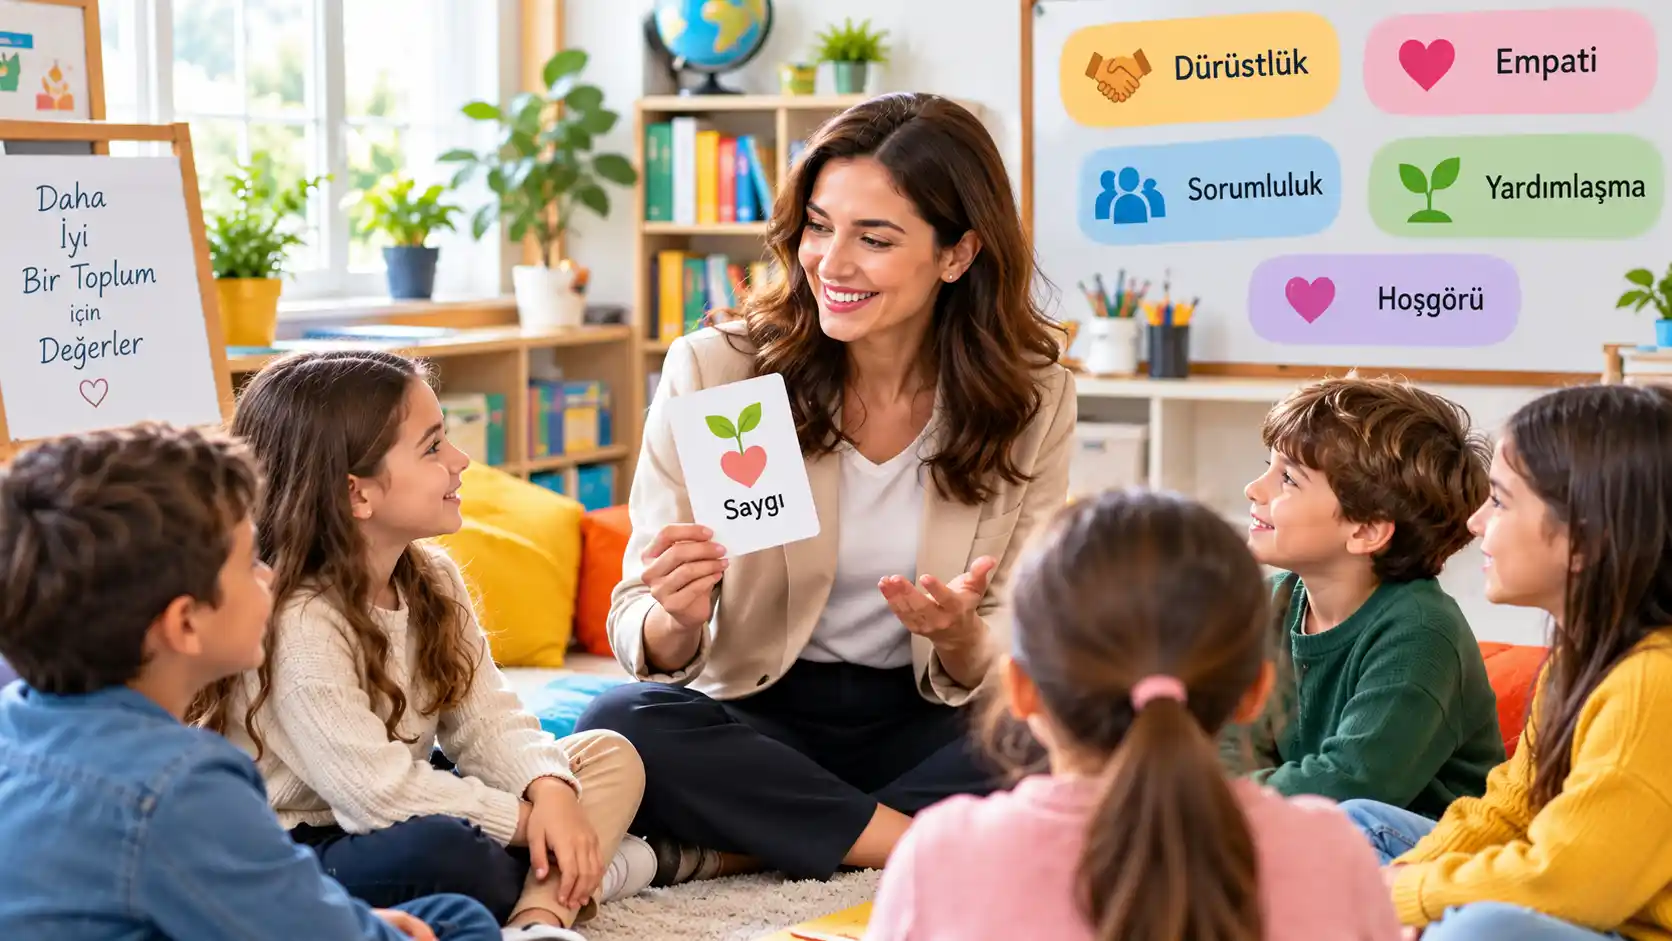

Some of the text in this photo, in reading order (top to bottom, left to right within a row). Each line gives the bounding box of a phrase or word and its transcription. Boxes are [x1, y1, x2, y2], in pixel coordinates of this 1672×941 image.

[1174, 47, 1309, 81] Dürüstlük
[1496, 45, 1598, 81] Empati
[36, 181, 107, 212] Daha
[1187, 170, 1324, 202] Sorumluluk
[1485, 172, 1647, 205] Yardımlaşma
[60, 217, 88, 258] İyi
[22, 259, 157, 298] Bir Toplum
[70, 303, 101, 327] için
[1378, 286, 1484, 318] Hoşgörü
[39, 329, 144, 371] Değerler
[723, 493, 785, 521] Saygı
